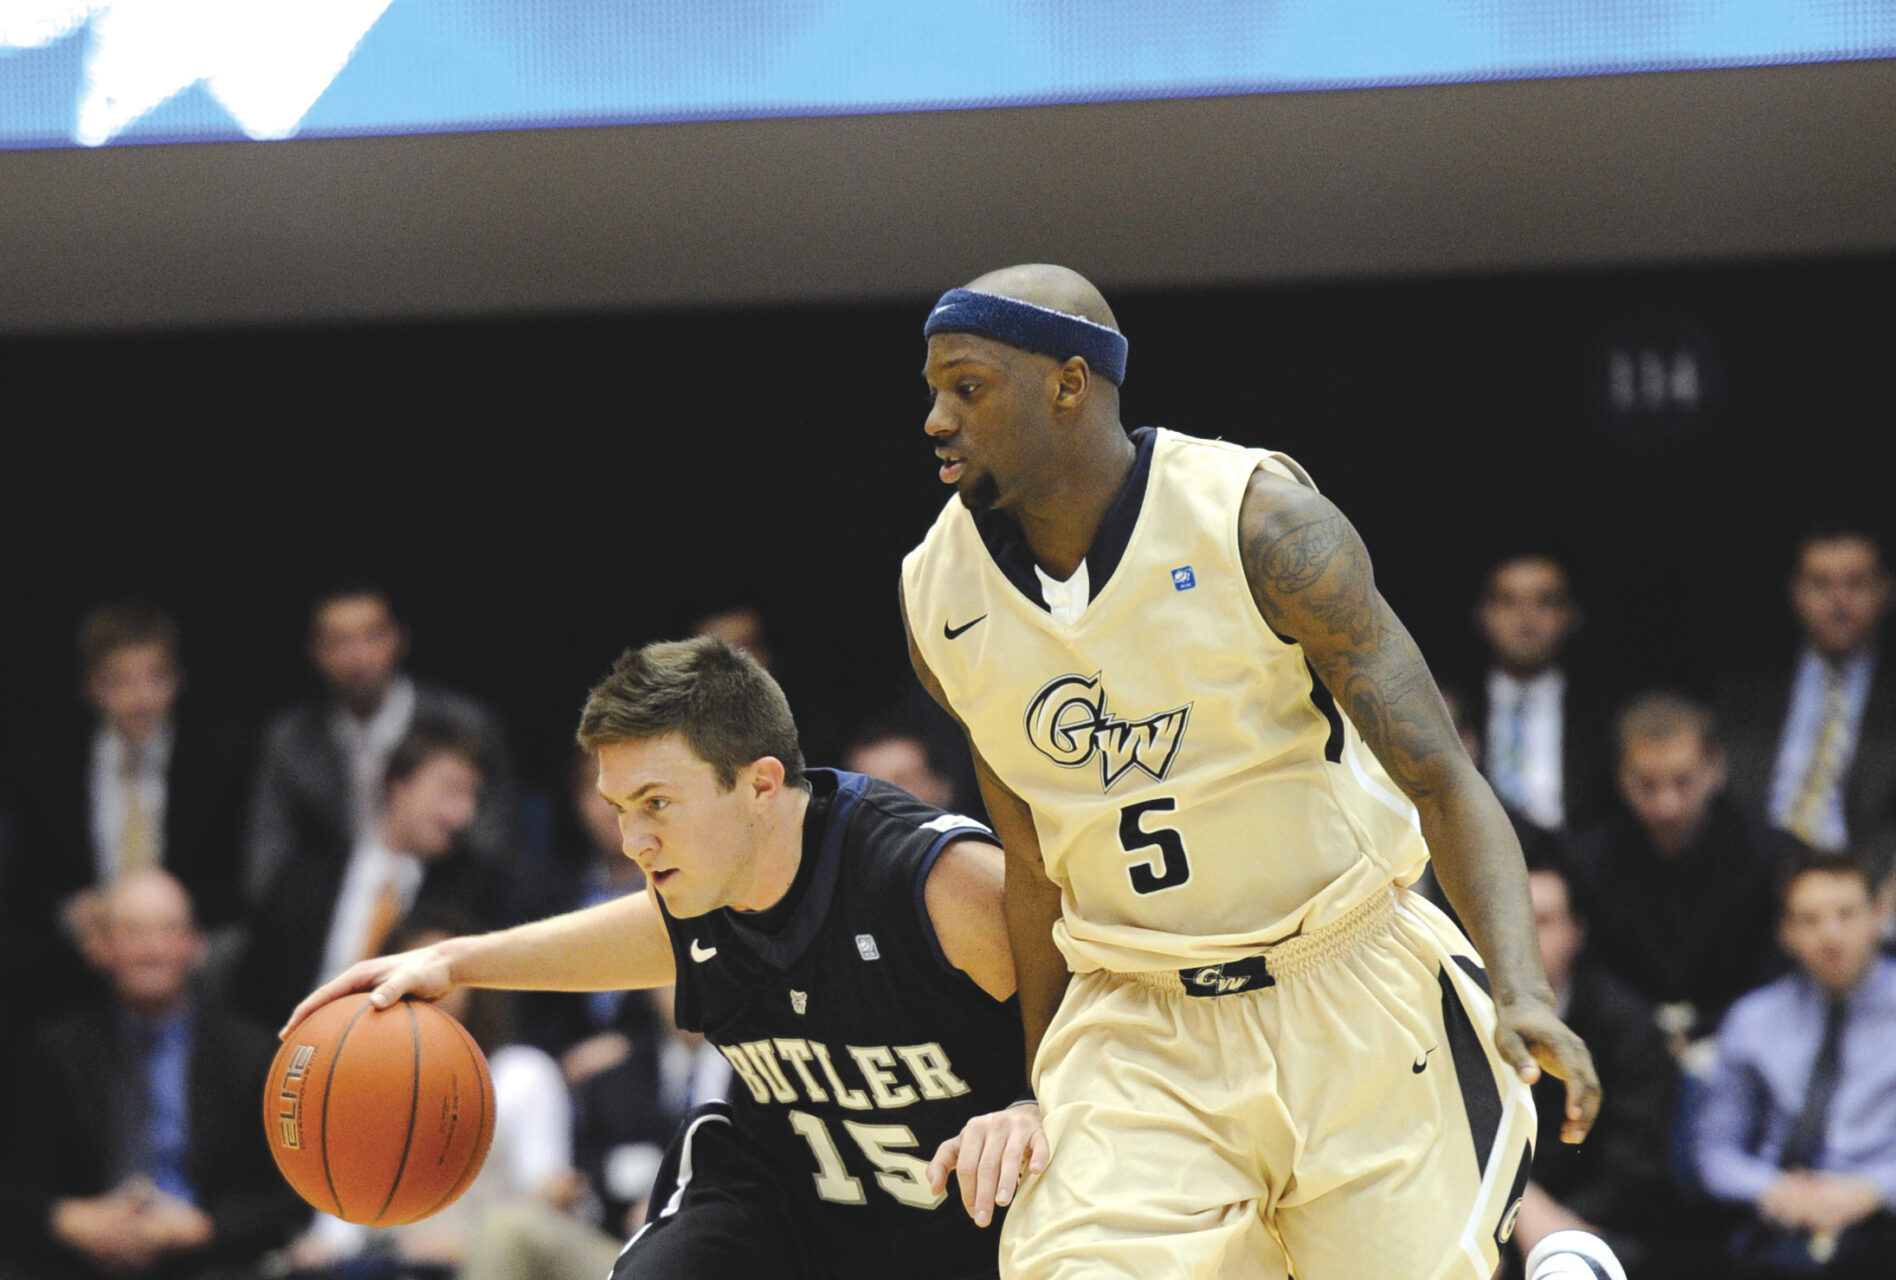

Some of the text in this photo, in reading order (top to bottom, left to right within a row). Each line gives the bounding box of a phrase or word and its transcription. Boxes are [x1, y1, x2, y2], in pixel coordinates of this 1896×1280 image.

[1023, 669, 1194, 795] GW
[1118, 796, 1191, 896] 5
[718, 1037, 972, 1110] BUTLER
[788, 1109, 949, 1210] 15
